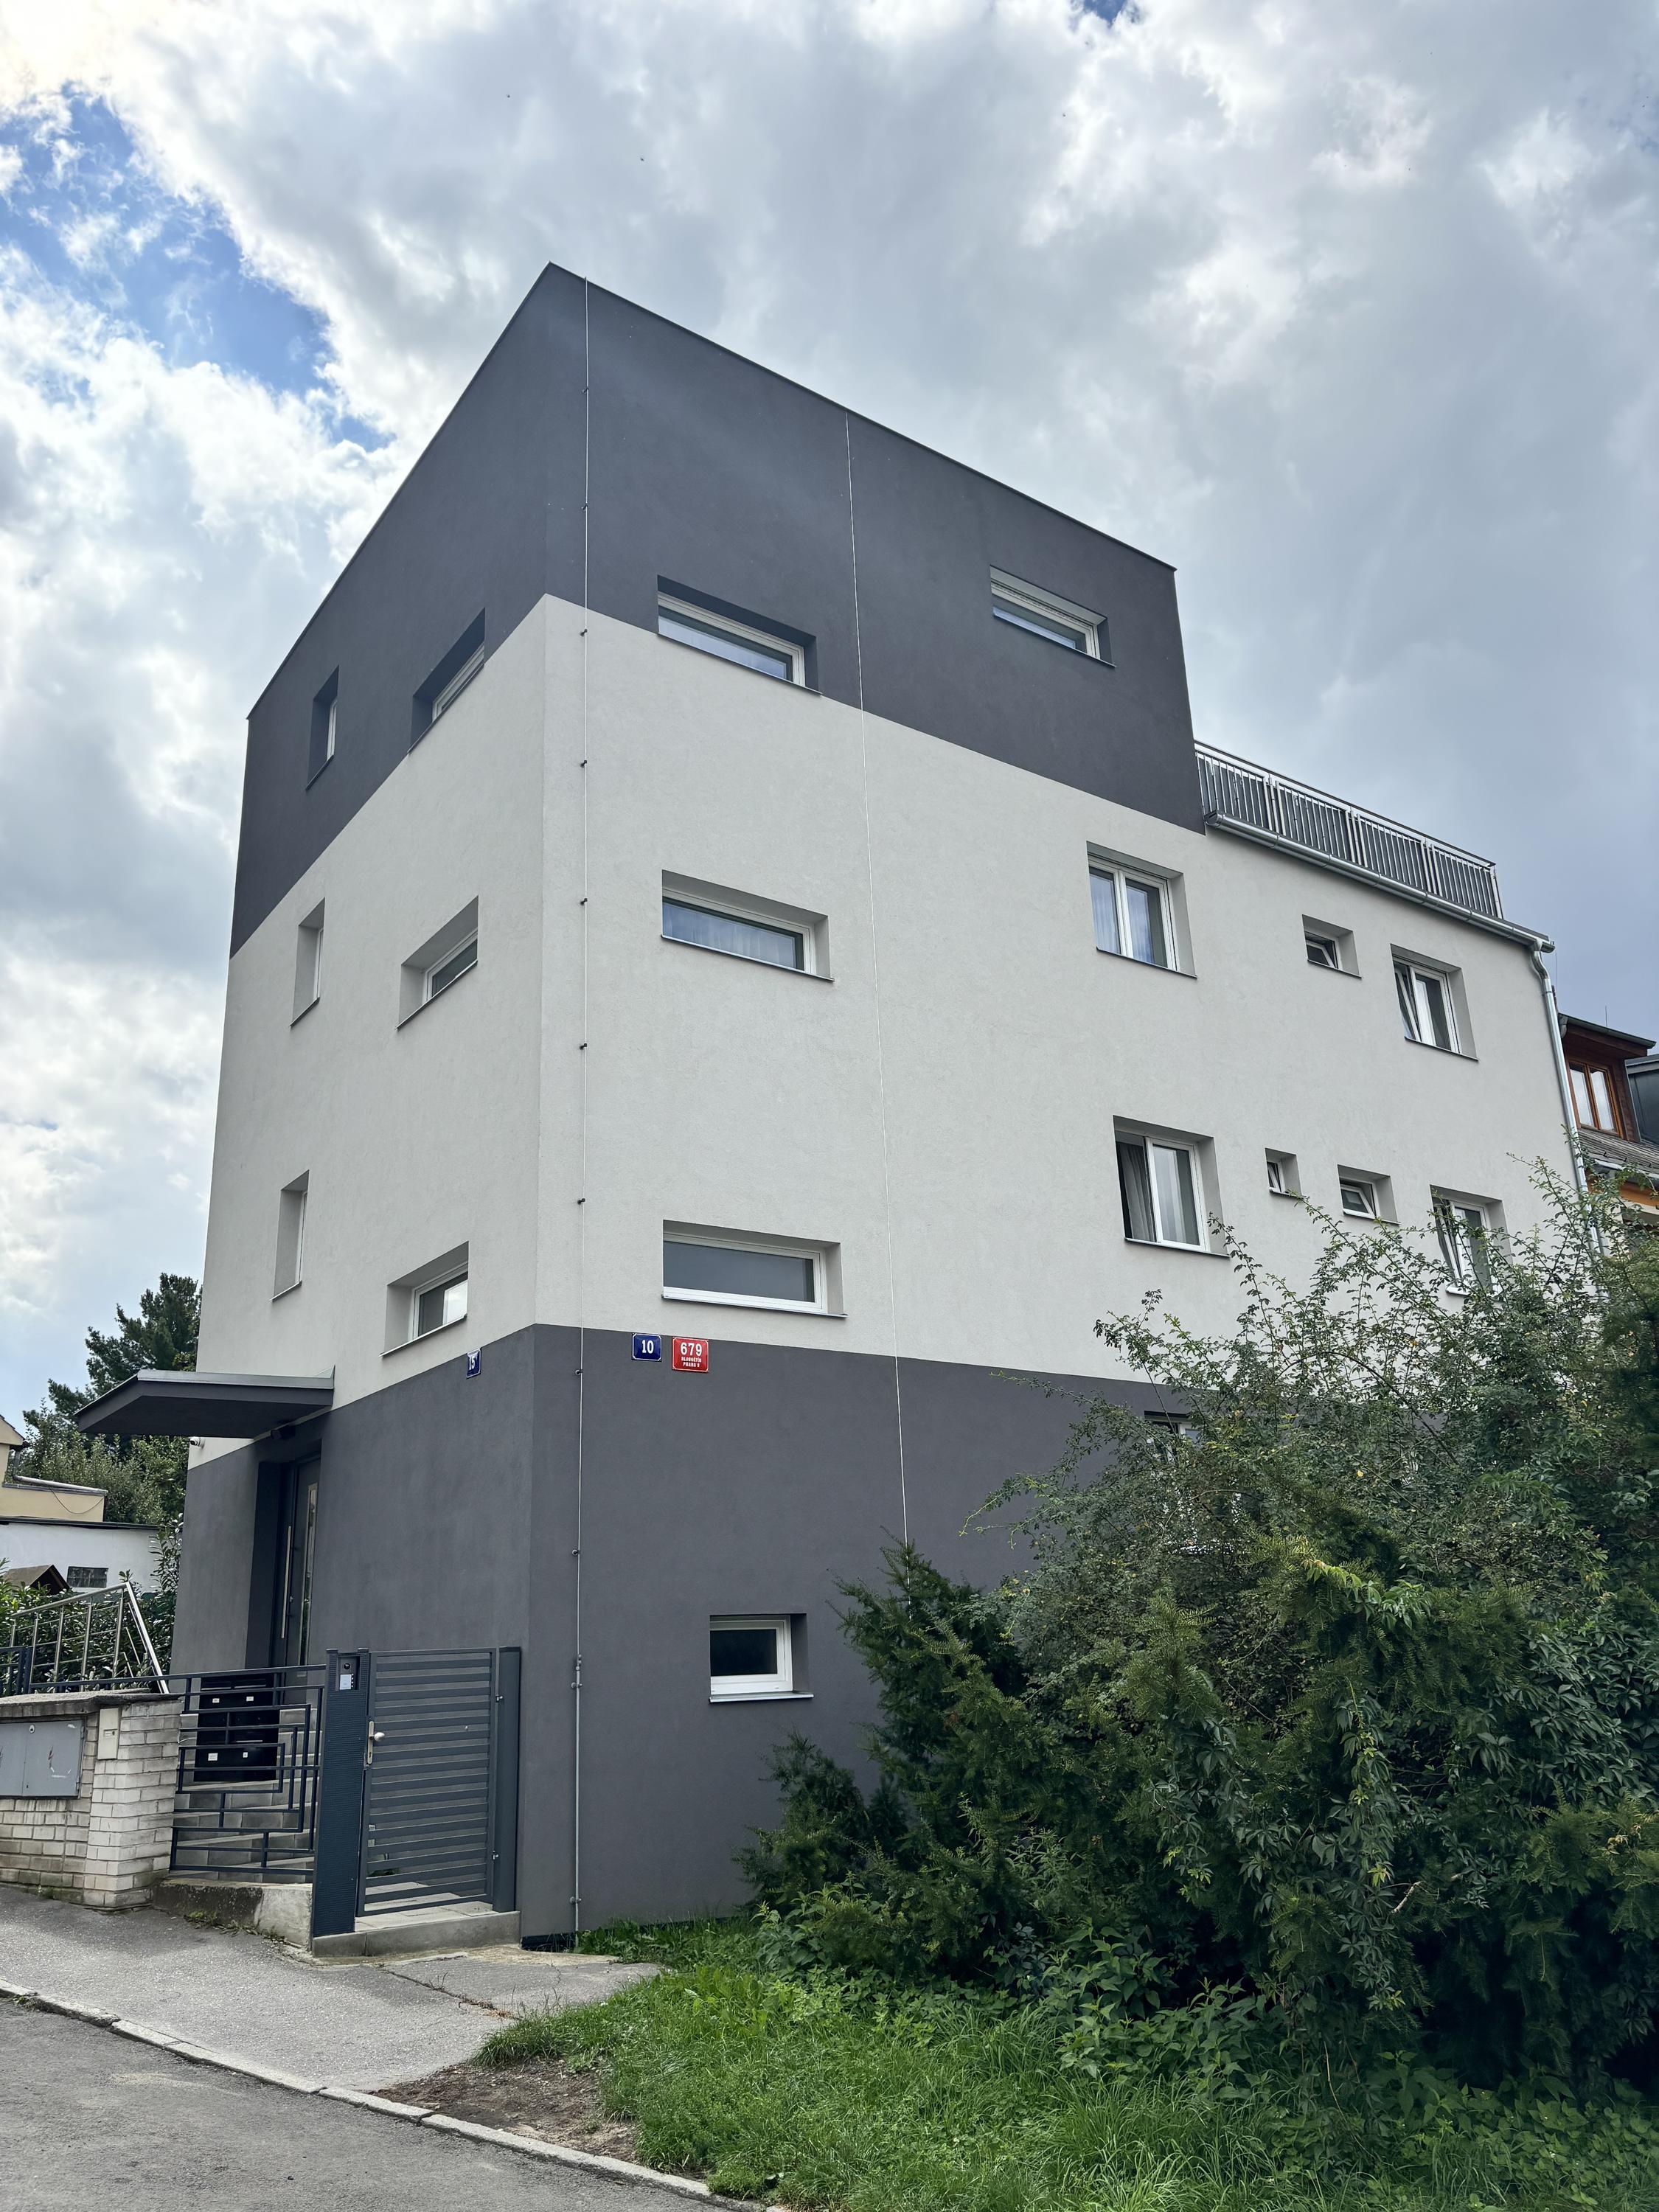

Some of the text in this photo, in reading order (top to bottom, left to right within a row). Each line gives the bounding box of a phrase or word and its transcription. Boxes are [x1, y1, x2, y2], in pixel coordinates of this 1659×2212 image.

[641, 1340, 654, 1354] 10
[680, 1342, 702, 1357] 679
[469, 1356, 476, 1371] 15
